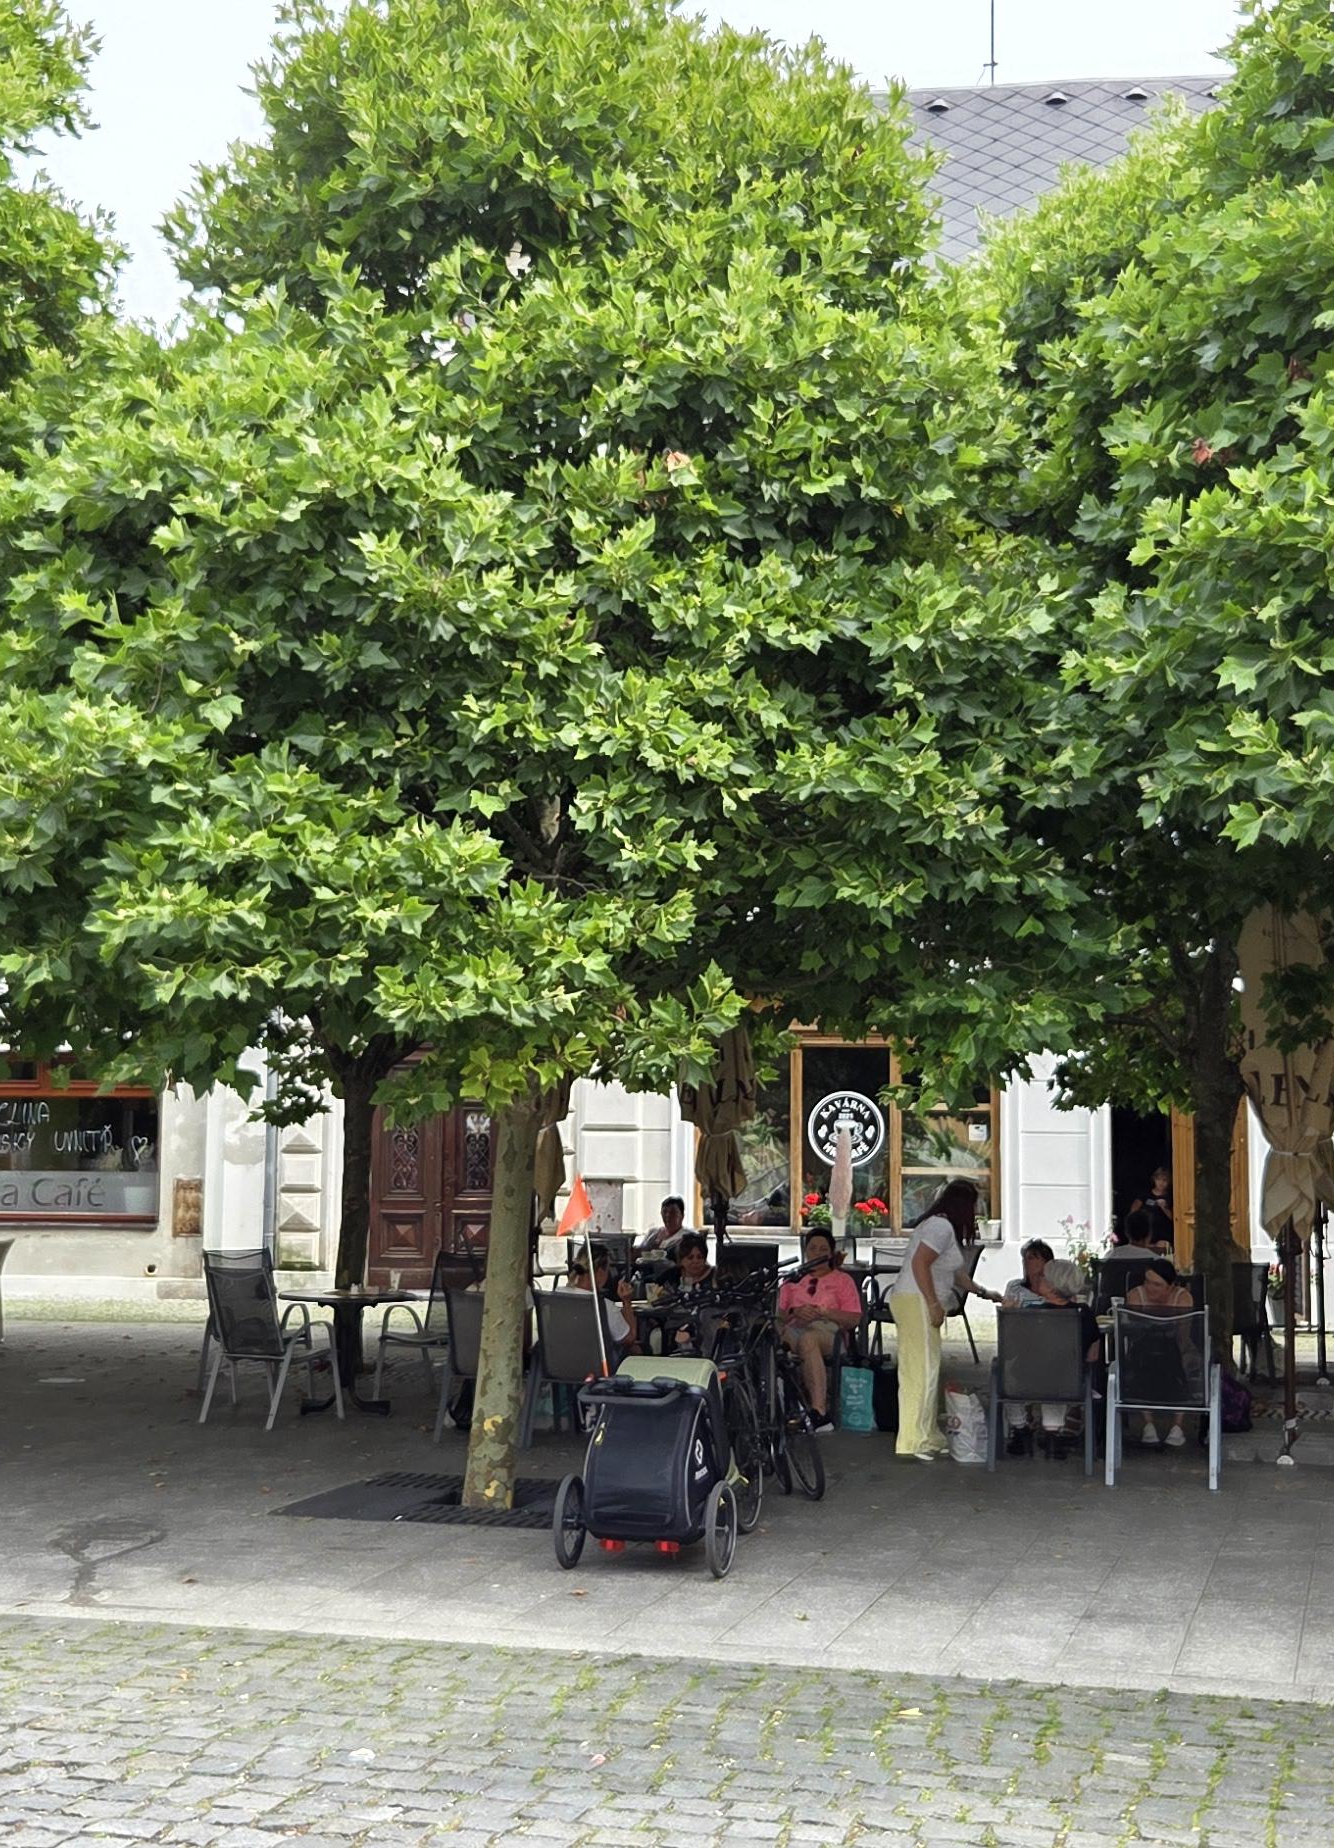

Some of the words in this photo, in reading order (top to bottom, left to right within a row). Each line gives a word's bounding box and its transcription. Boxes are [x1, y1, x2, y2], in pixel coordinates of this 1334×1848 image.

[820, 1097, 870, 1119] KAVÁRNA
[822, 1141, 870, 1159] HRAFÉ
[31, 1177, 106, 1207] Café
